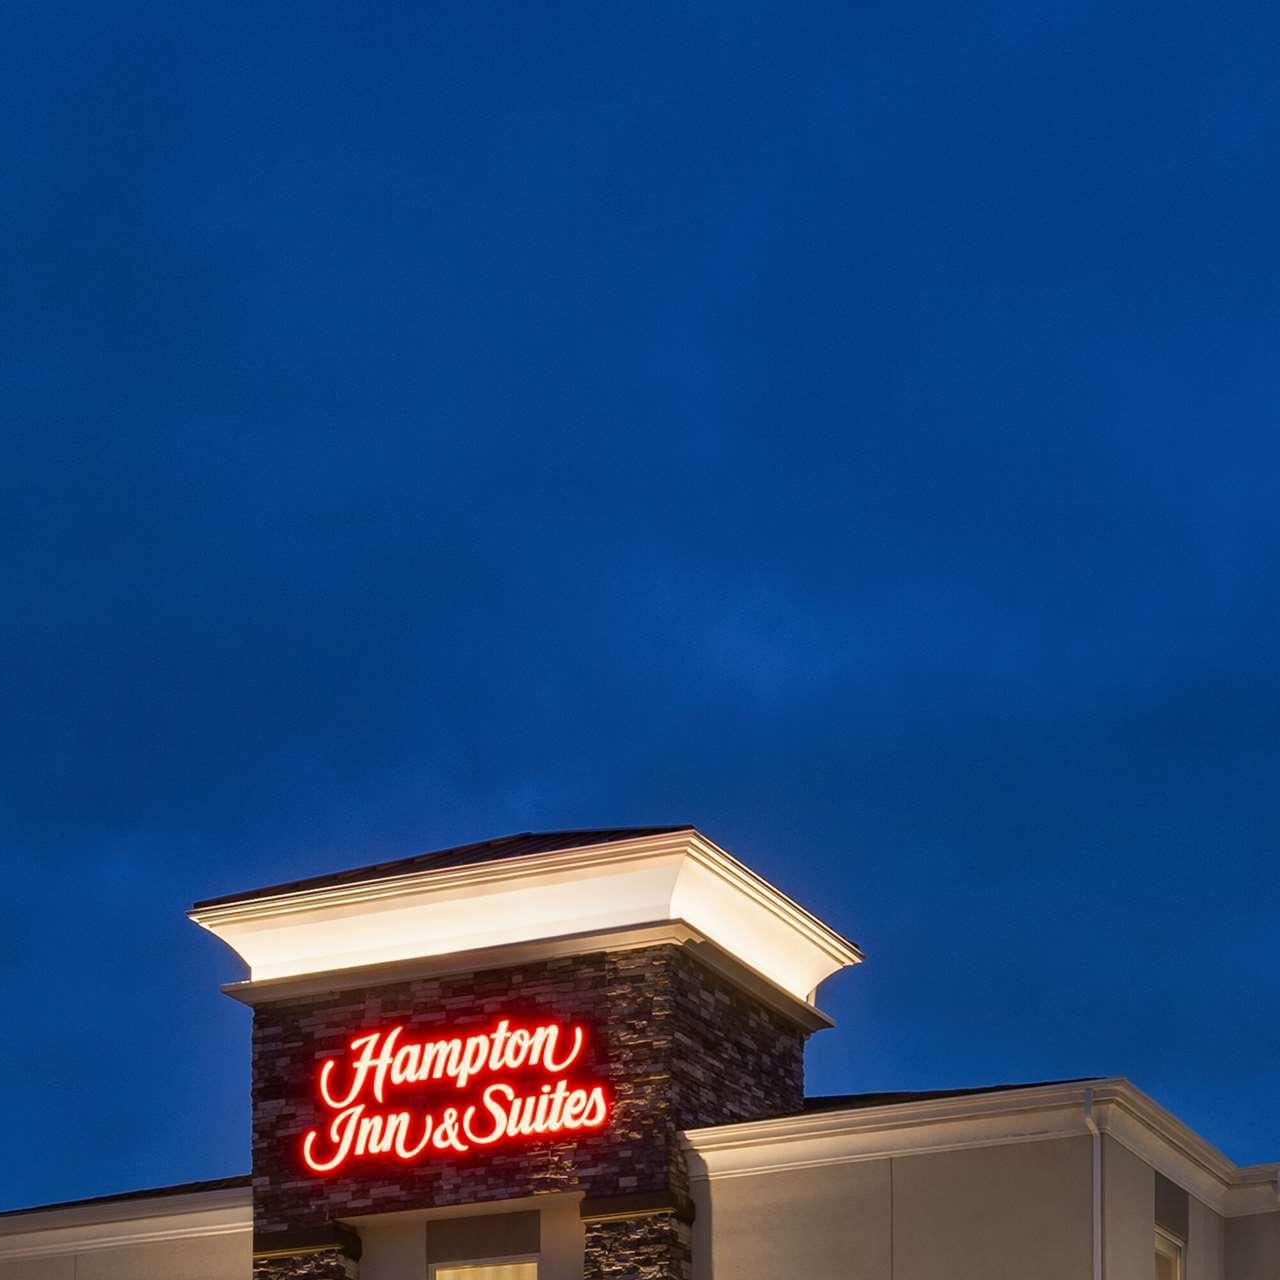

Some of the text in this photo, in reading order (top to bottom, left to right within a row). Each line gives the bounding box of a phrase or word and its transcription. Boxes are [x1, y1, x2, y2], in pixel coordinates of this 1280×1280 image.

[320, 1020, 582, 1109] Hampton
[304, 1080, 607, 1171] Inn & Suites
